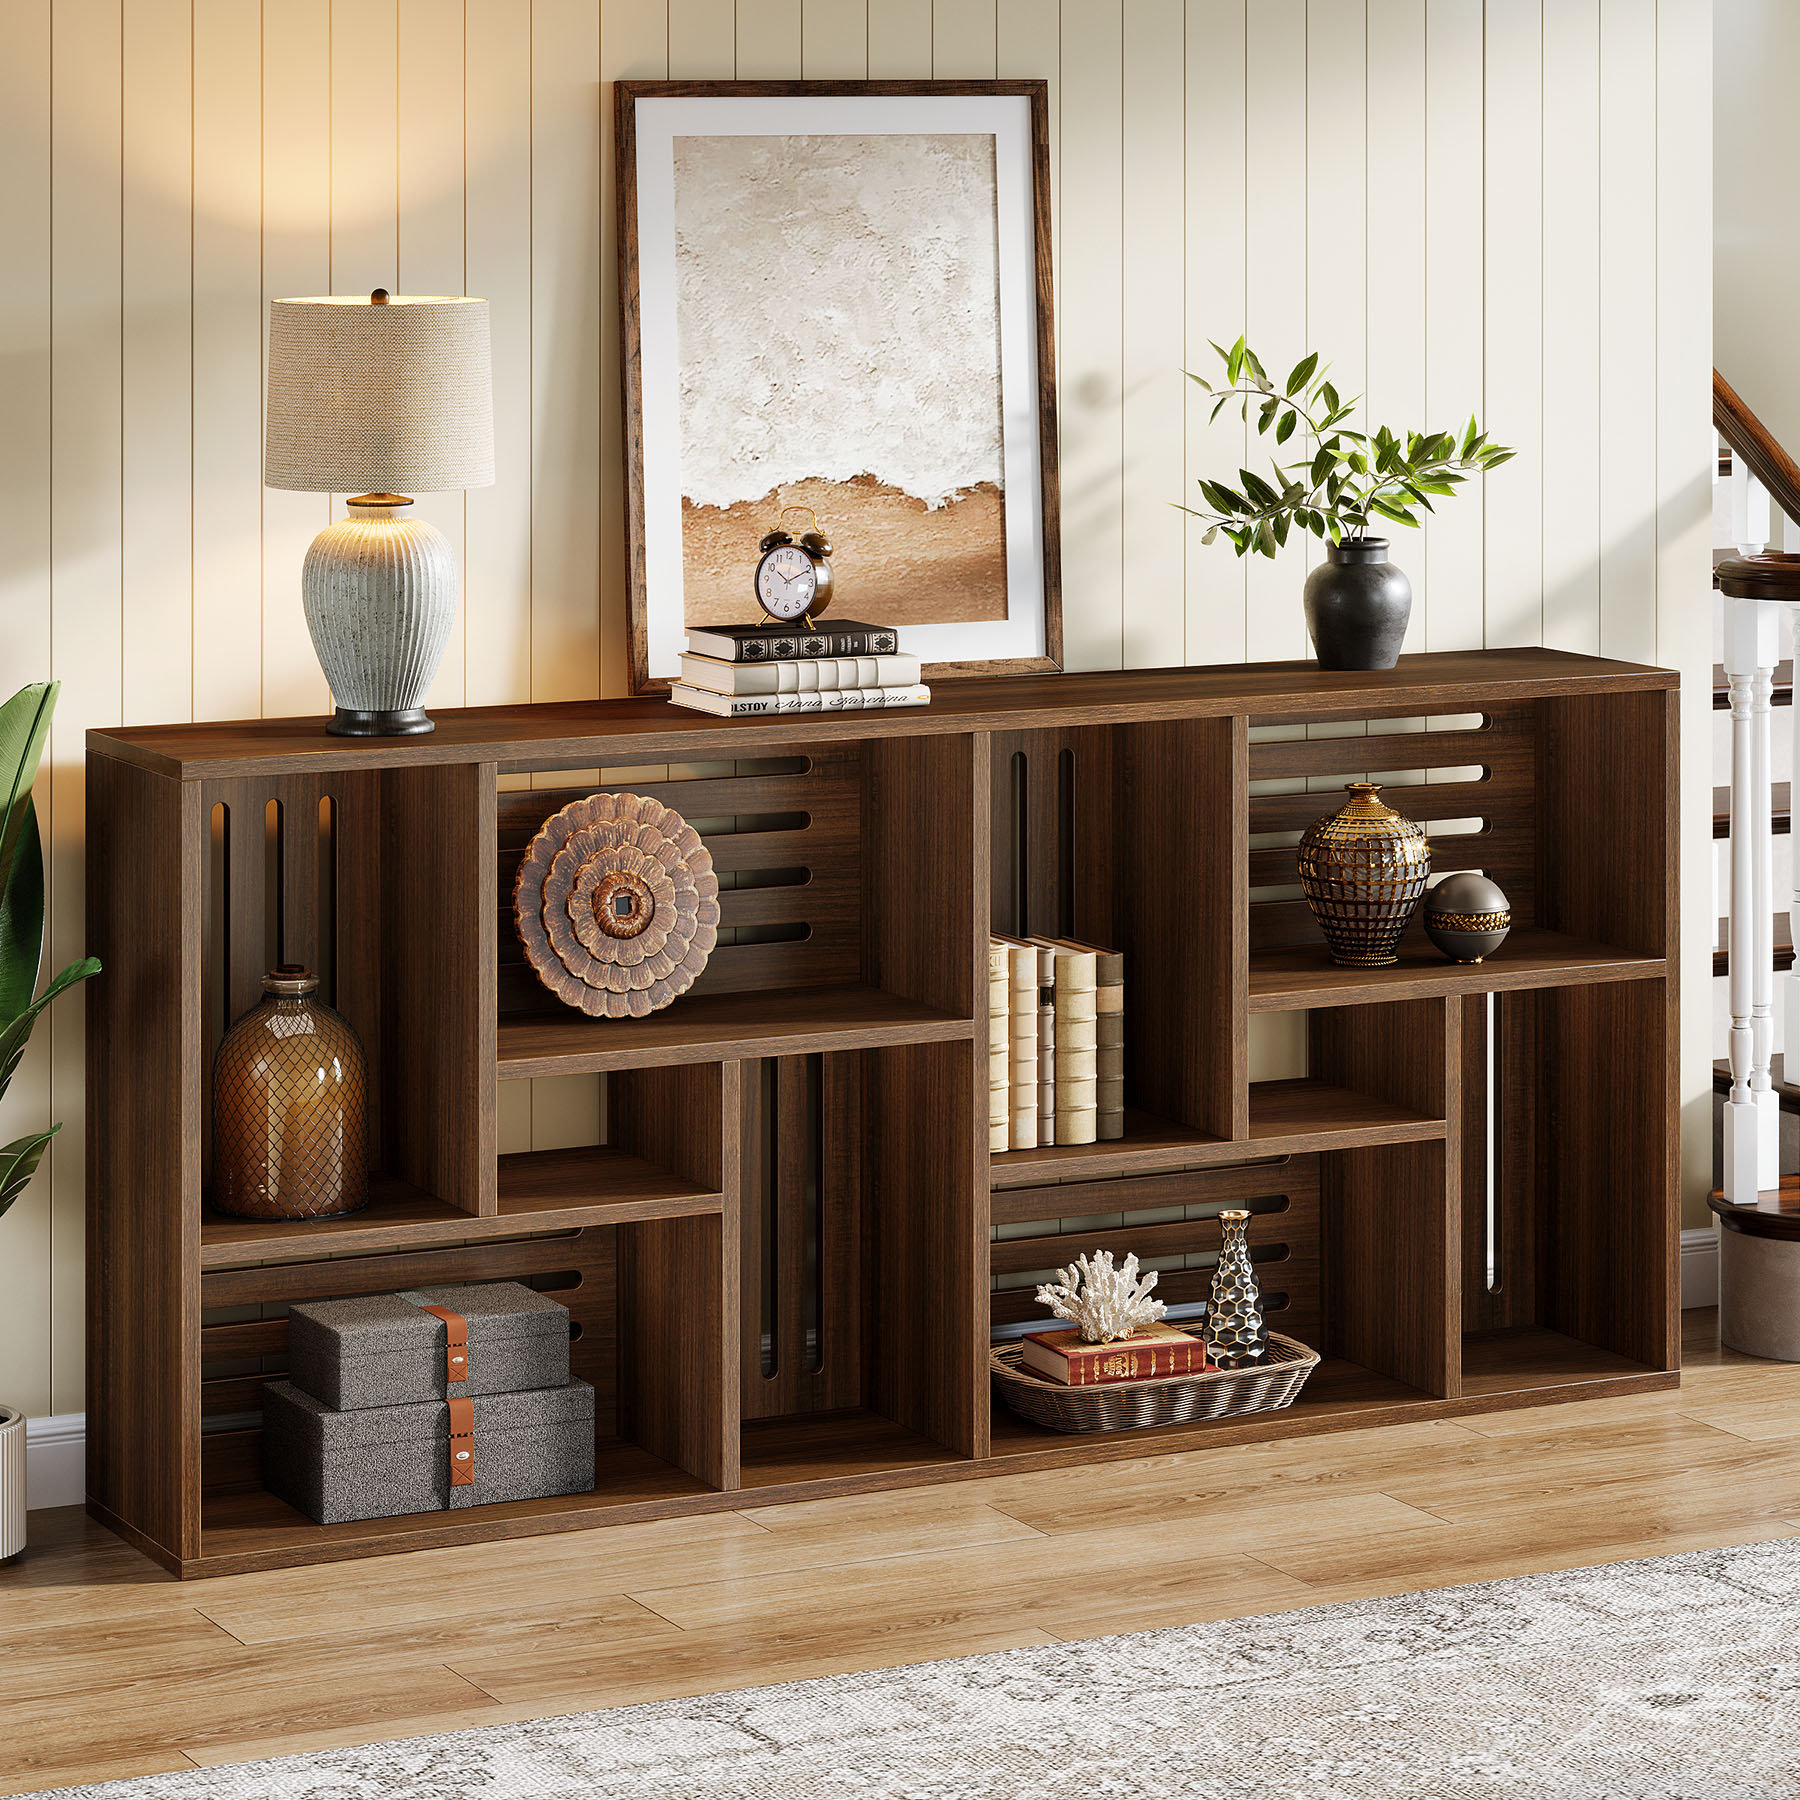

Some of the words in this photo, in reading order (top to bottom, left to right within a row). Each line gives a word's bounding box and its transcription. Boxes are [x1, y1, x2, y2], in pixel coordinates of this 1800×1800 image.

[776, 555, 782, 563] 11
[786, 551, 793, 560] 12
[768, 562, 775, 572] 10
[806, 565, 811, 573] 2
[764, 575, 769, 583] 9
[808, 578, 813, 587] 3
[766, 588, 771, 597] 8
[804, 592, 809, 600] 4
[774, 598, 779, 607] 7
[795, 600, 800, 609] 5
[784, 603, 789, 612] 6
[731, 702, 768, 712] LSTOY
[775, 700, 822, 709] Anna
[829, 694, 908, 707] Karenina
